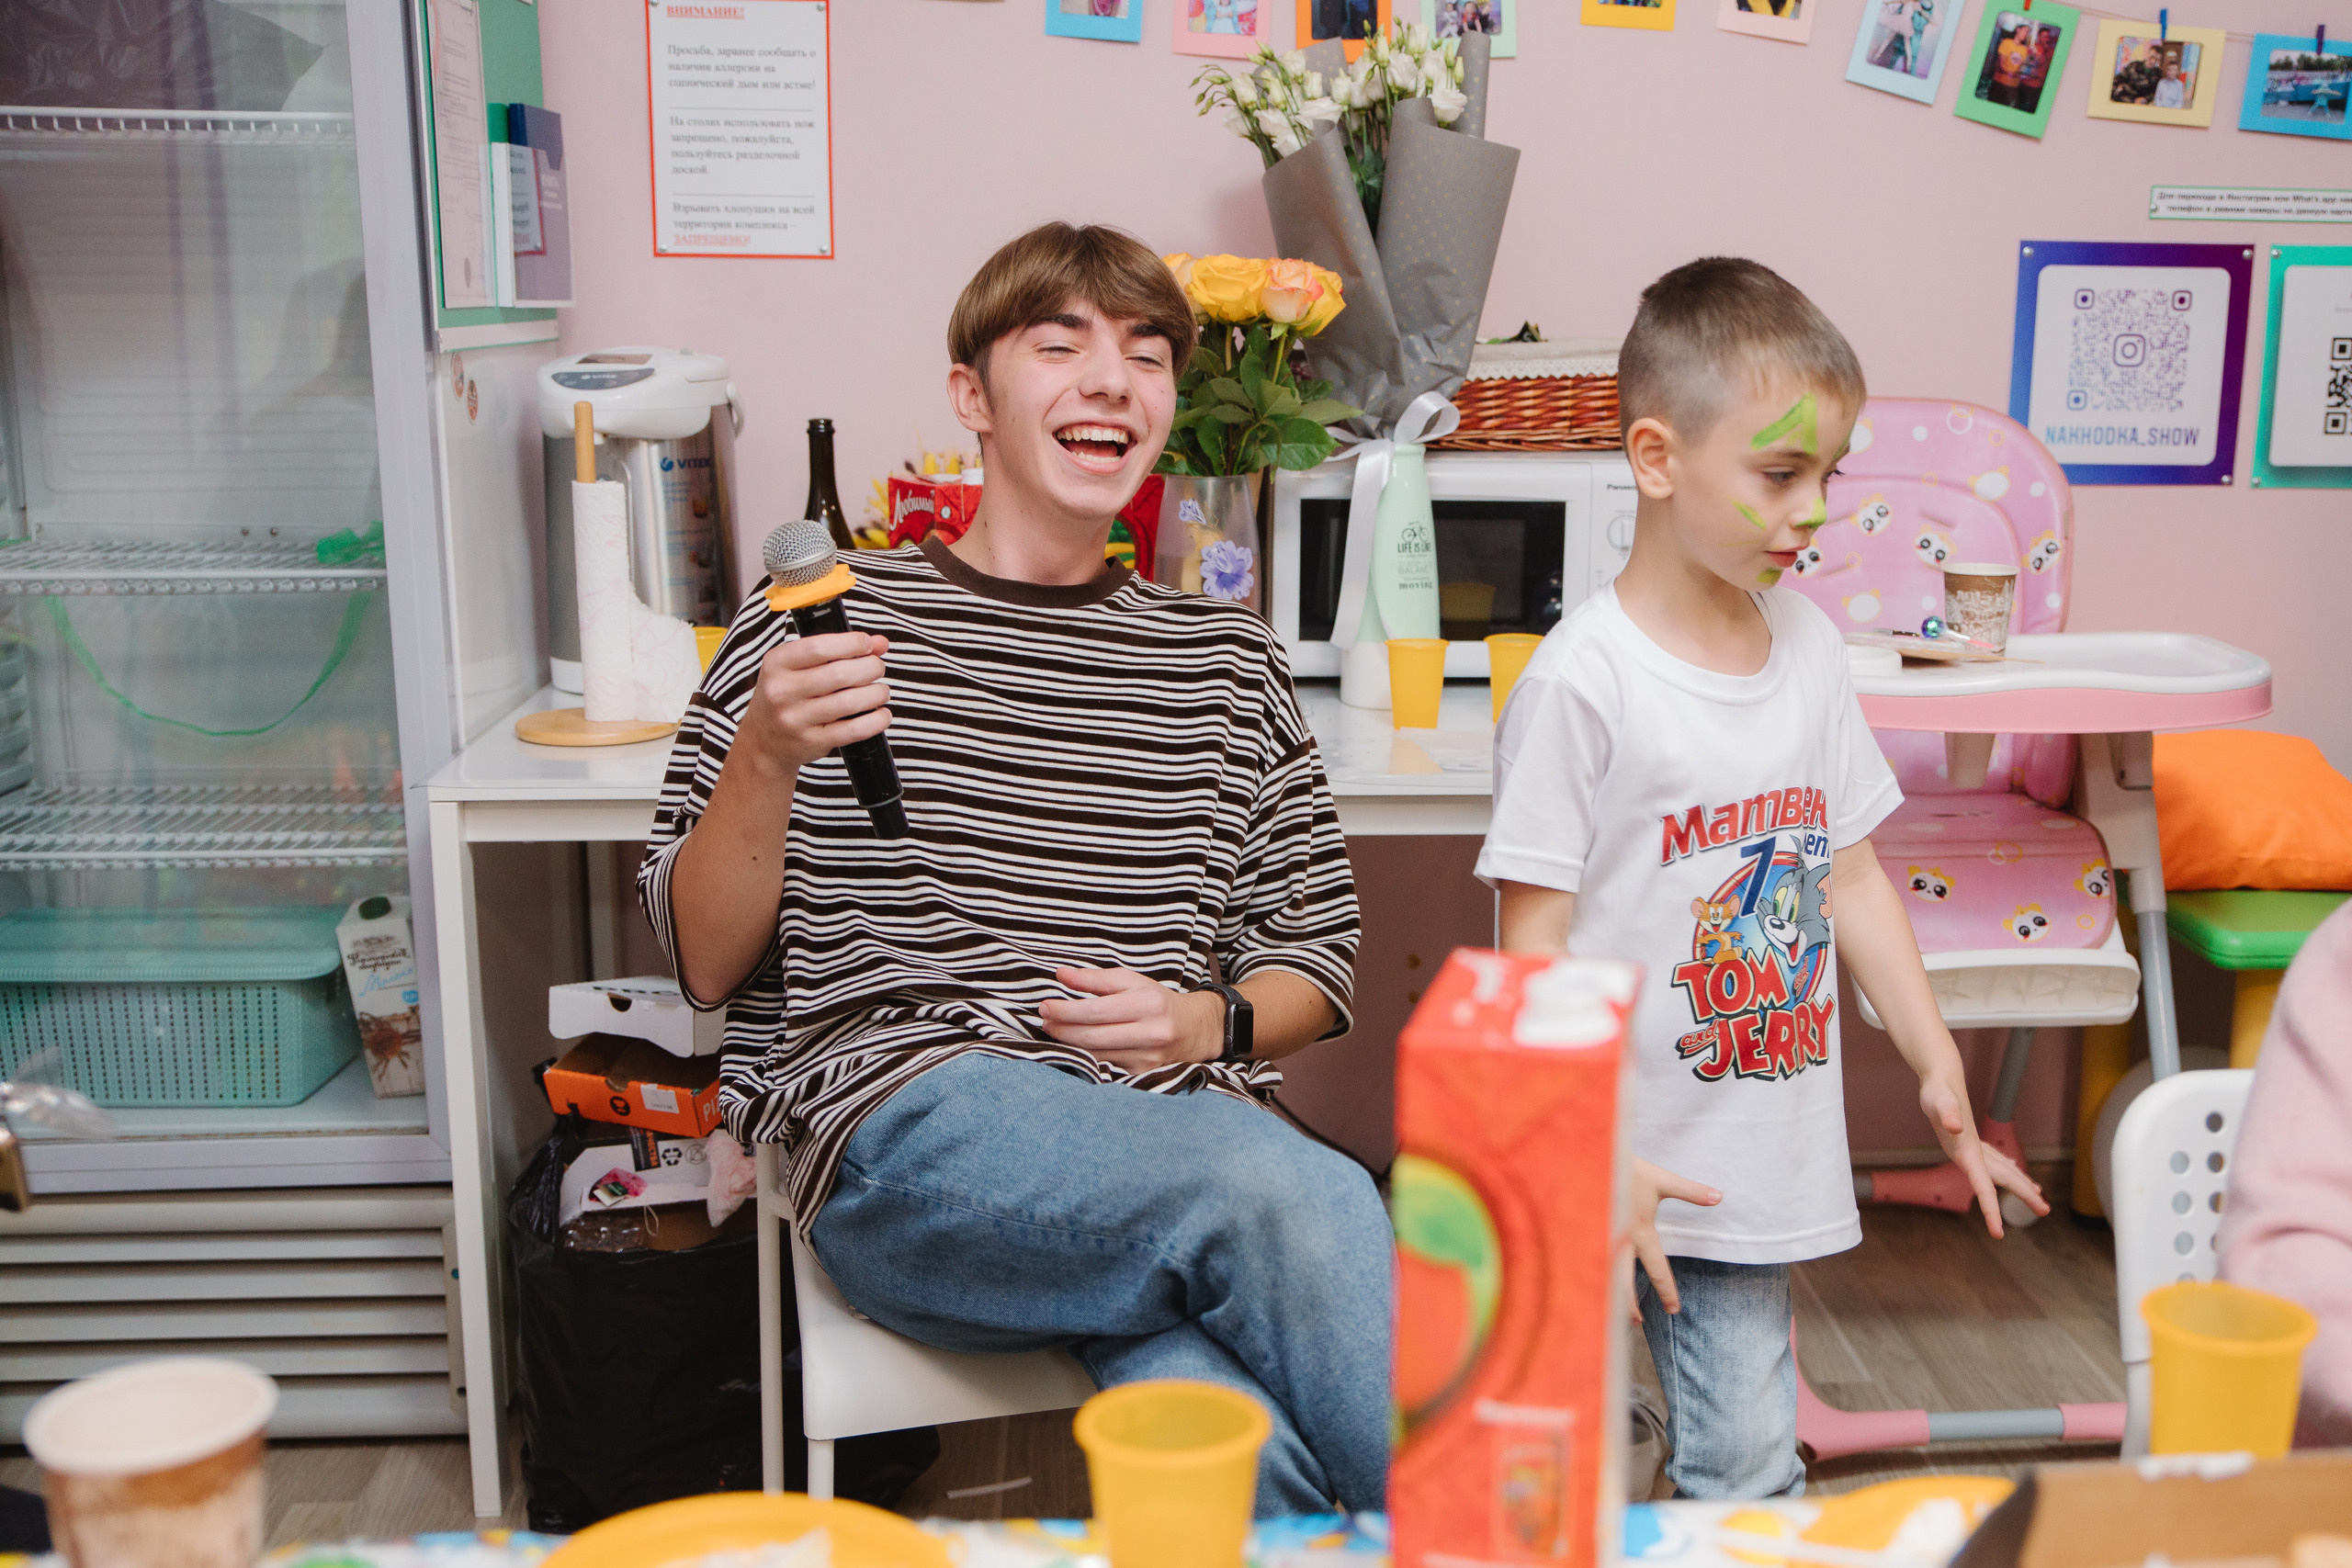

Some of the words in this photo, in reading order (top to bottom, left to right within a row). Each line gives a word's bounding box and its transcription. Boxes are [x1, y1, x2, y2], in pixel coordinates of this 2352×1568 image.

[666, 5, 744, 19] ВНИМАНИЕ!
[668, 45, 714, 57] Просьба,
[1397, 543, 1412, 553] LIFE
[1414, 543, 1420, 552] IS
[1740, 835, 1777, 918] 7
[1671, 944, 1791, 1024] TOM
[1676, 1018, 1720, 1055] and
[1692, 993, 1836, 1082] JERRY
